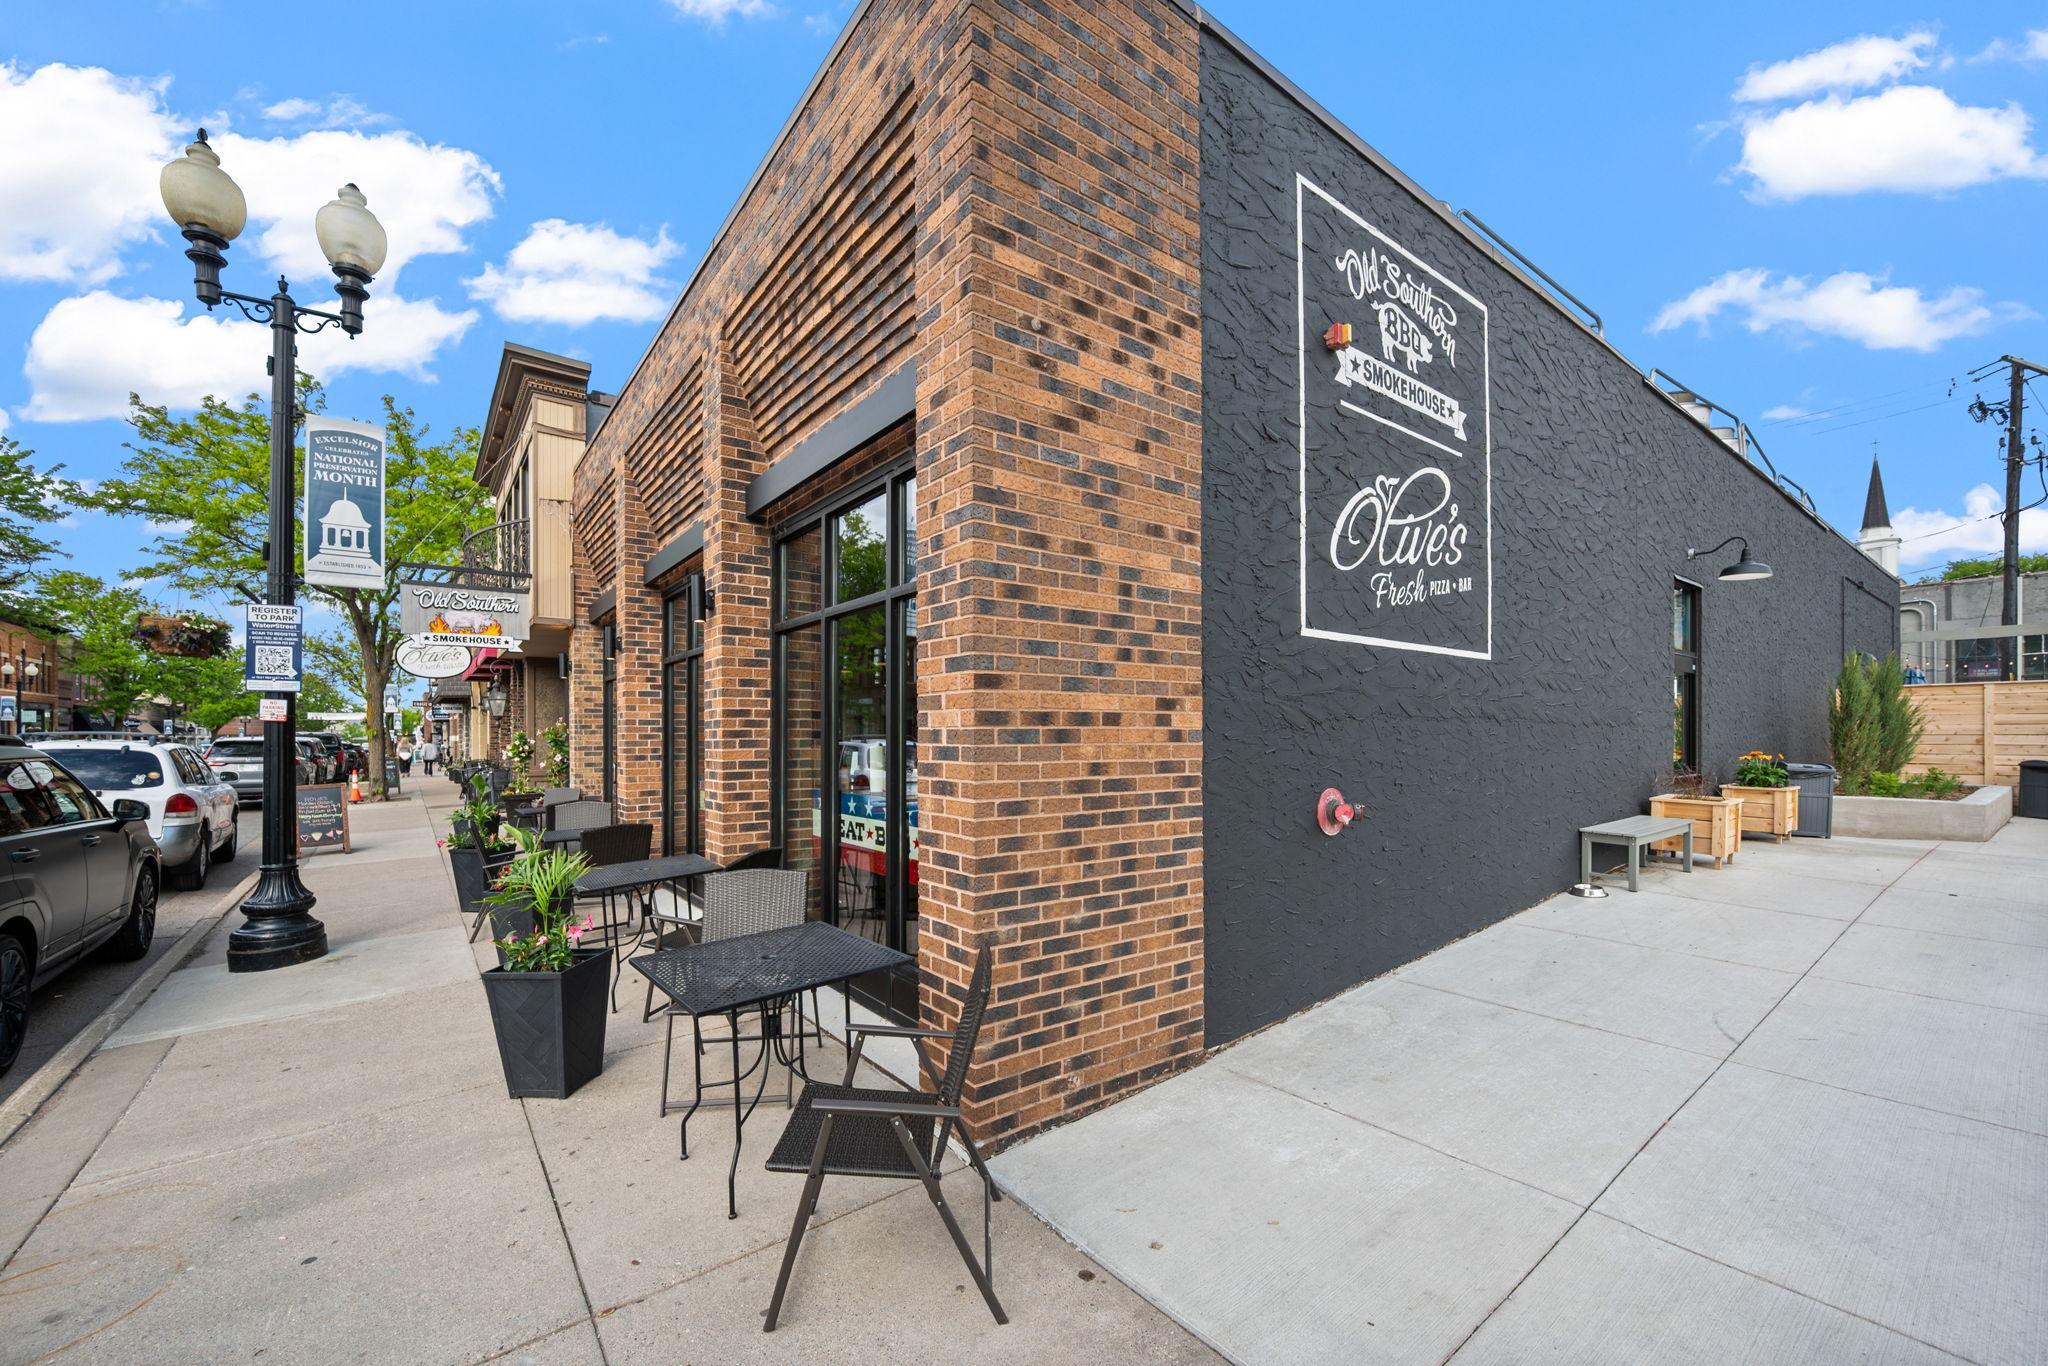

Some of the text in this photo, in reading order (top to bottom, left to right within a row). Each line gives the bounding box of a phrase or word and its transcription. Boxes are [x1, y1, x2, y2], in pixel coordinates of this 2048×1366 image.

[1336, 247, 1457, 368] Old Southern
[1385, 307, 1424, 358] BBQ
[1363, 360, 1446, 418] SMOKEHOUSE
[315, 435, 378, 452] EXCELSIOR
[324, 445, 369, 456] CELEBRATES
[313, 461, 378, 476] PRESERVATION
[314, 452, 378, 468] NATIONAL
[313, 469, 377, 488] MONTH
[1330, 467, 1467, 570] Olive's
[1371, 568, 1472, 608] Fresh PIZZA BAR
[412, 588, 520, 613] Old Southern
[251, 606, 298, 616] REGISTER
[432, 634, 502, 645] SMOKEHOUSE
